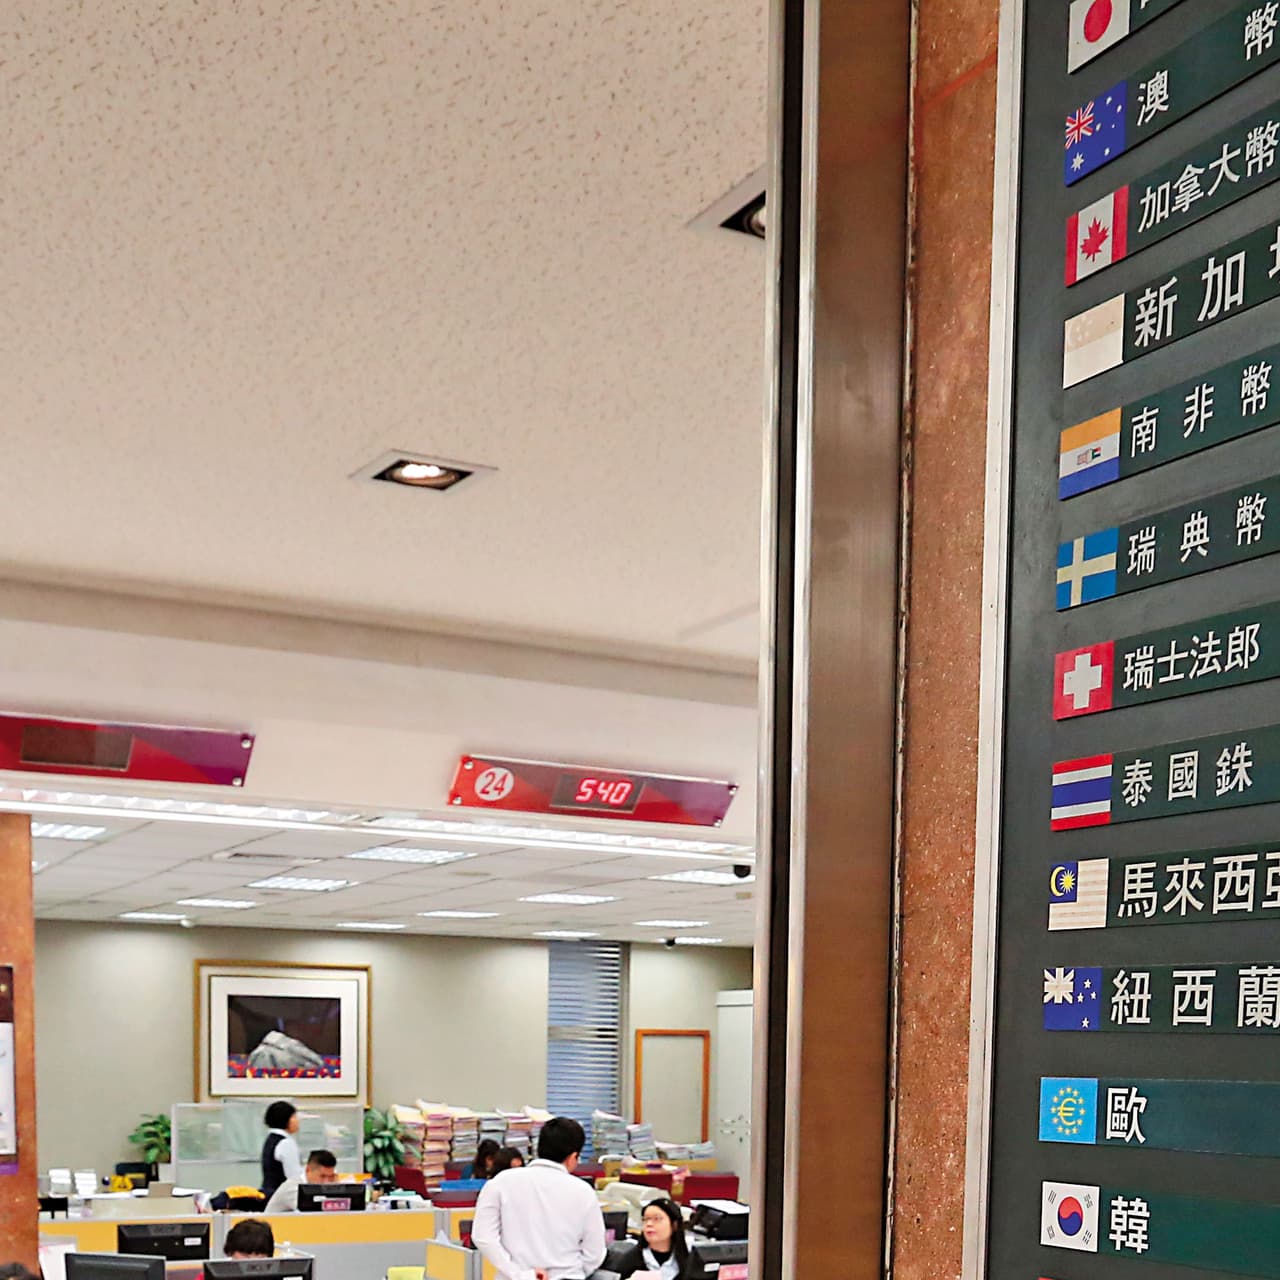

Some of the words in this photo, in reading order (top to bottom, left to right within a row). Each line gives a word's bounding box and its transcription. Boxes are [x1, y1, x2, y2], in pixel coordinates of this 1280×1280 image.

[1136, 0, 1279, 127] 澳幣
[1137, 120, 1280, 233] 加拿大幣
[1130, 360, 1273, 458] 南非幣
[1126, 492, 1267, 576] 瑞典幣
[1122, 623, 1261, 692] 瑞士法郎
[480, 771, 506, 796] 24
[575, 778, 633, 804] 540
[1121, 742, 1253, 807] 泰國銖
